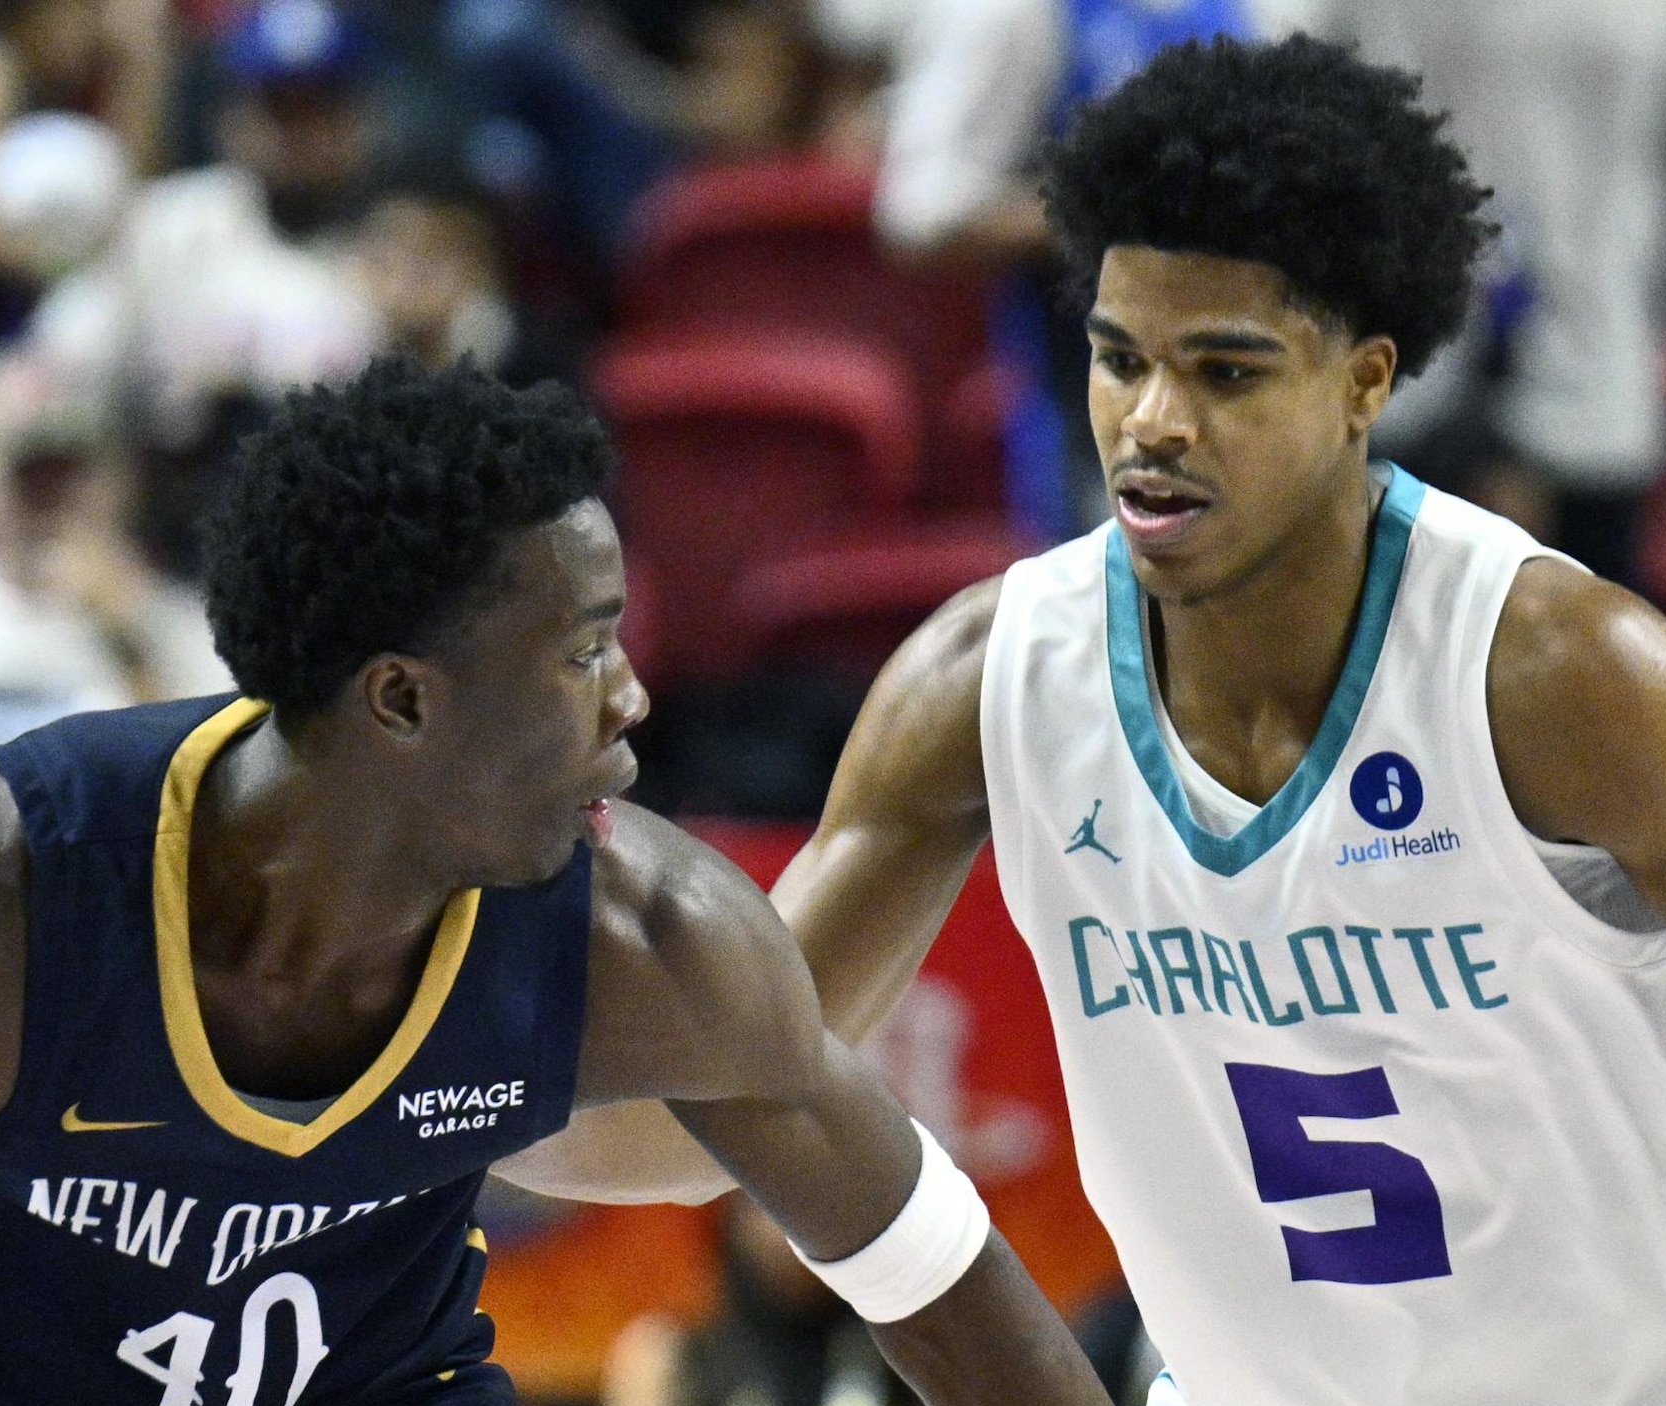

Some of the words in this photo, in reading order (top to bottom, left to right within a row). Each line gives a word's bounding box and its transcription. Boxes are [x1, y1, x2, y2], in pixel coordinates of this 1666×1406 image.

[1335, 836, 1389, 867] Judi
[1391, 826, 1461, 858] Health
[1068, 916, 1509, 1027] CHARLOTTE
[398, 1080, 525, 1121] NEWAGE
[418, 1112, 499, 1139] GARAGE
[1224, 1062, 1453, 1285] 5
[27, 1177, 199, 1268] NEW
